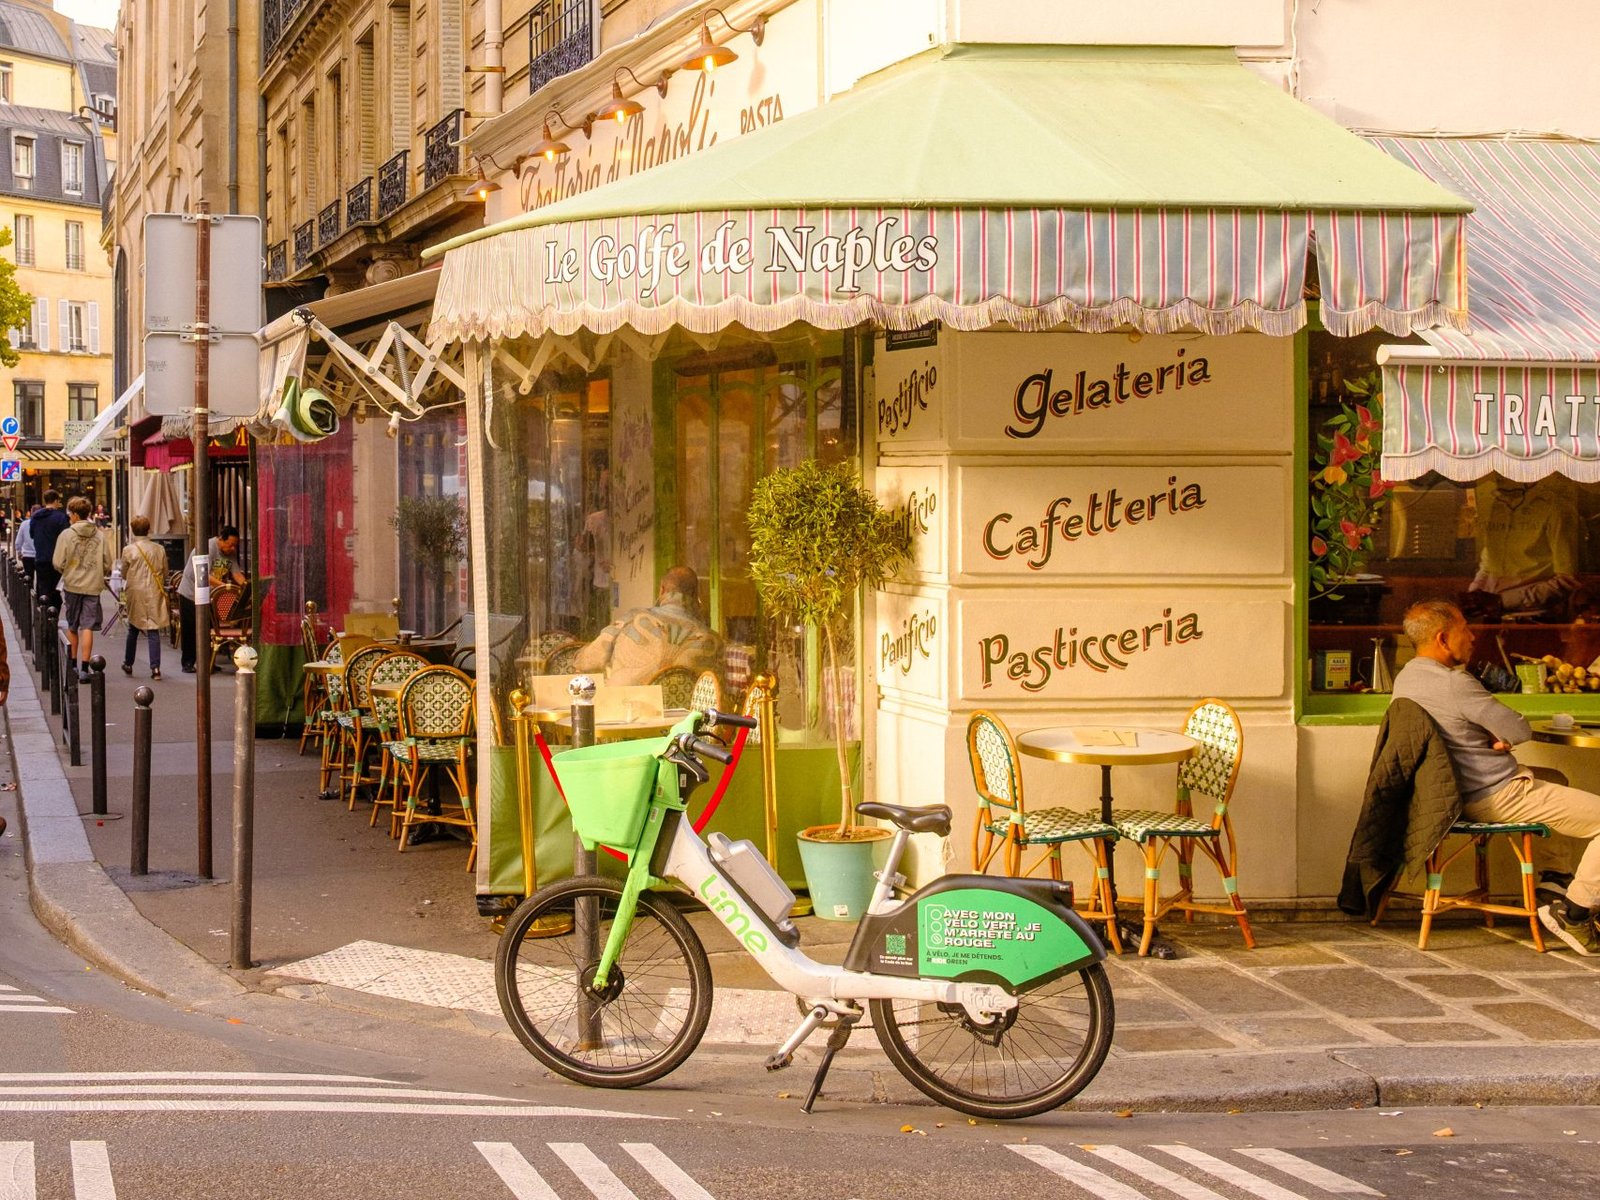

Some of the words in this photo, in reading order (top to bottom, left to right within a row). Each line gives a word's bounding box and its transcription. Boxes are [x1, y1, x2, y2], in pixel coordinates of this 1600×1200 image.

[626, 70, 718, 176] Napoli
[740, 93, 784, 135] PASTA
[545, 240, 580, 285] Le
[590, 224, 690, 299] Golfe
[701, 219, 755, 275] de
[764, 216, 939, 293] Naples
[878, 360, 937, 437] Pastificio
[982, 476, 1207, 571] Cafetteria
[881, 609, 937, 677] Panificio
[978, 607, 1204, 693] Pasticceria
[700, 874, 768, 954] Lime
[943, 909, 979, 919] AVEC
[982, 911, 1016, 921] MON
[943, 928, 1012, 940] M'ARRÊTE
[1015, 931, 1036, 941] AU
[944, 937, 996, 948] ROUGE.
[982, 920, 1021, 931] VERT,
[1024, 922, 1042, 931] JE
